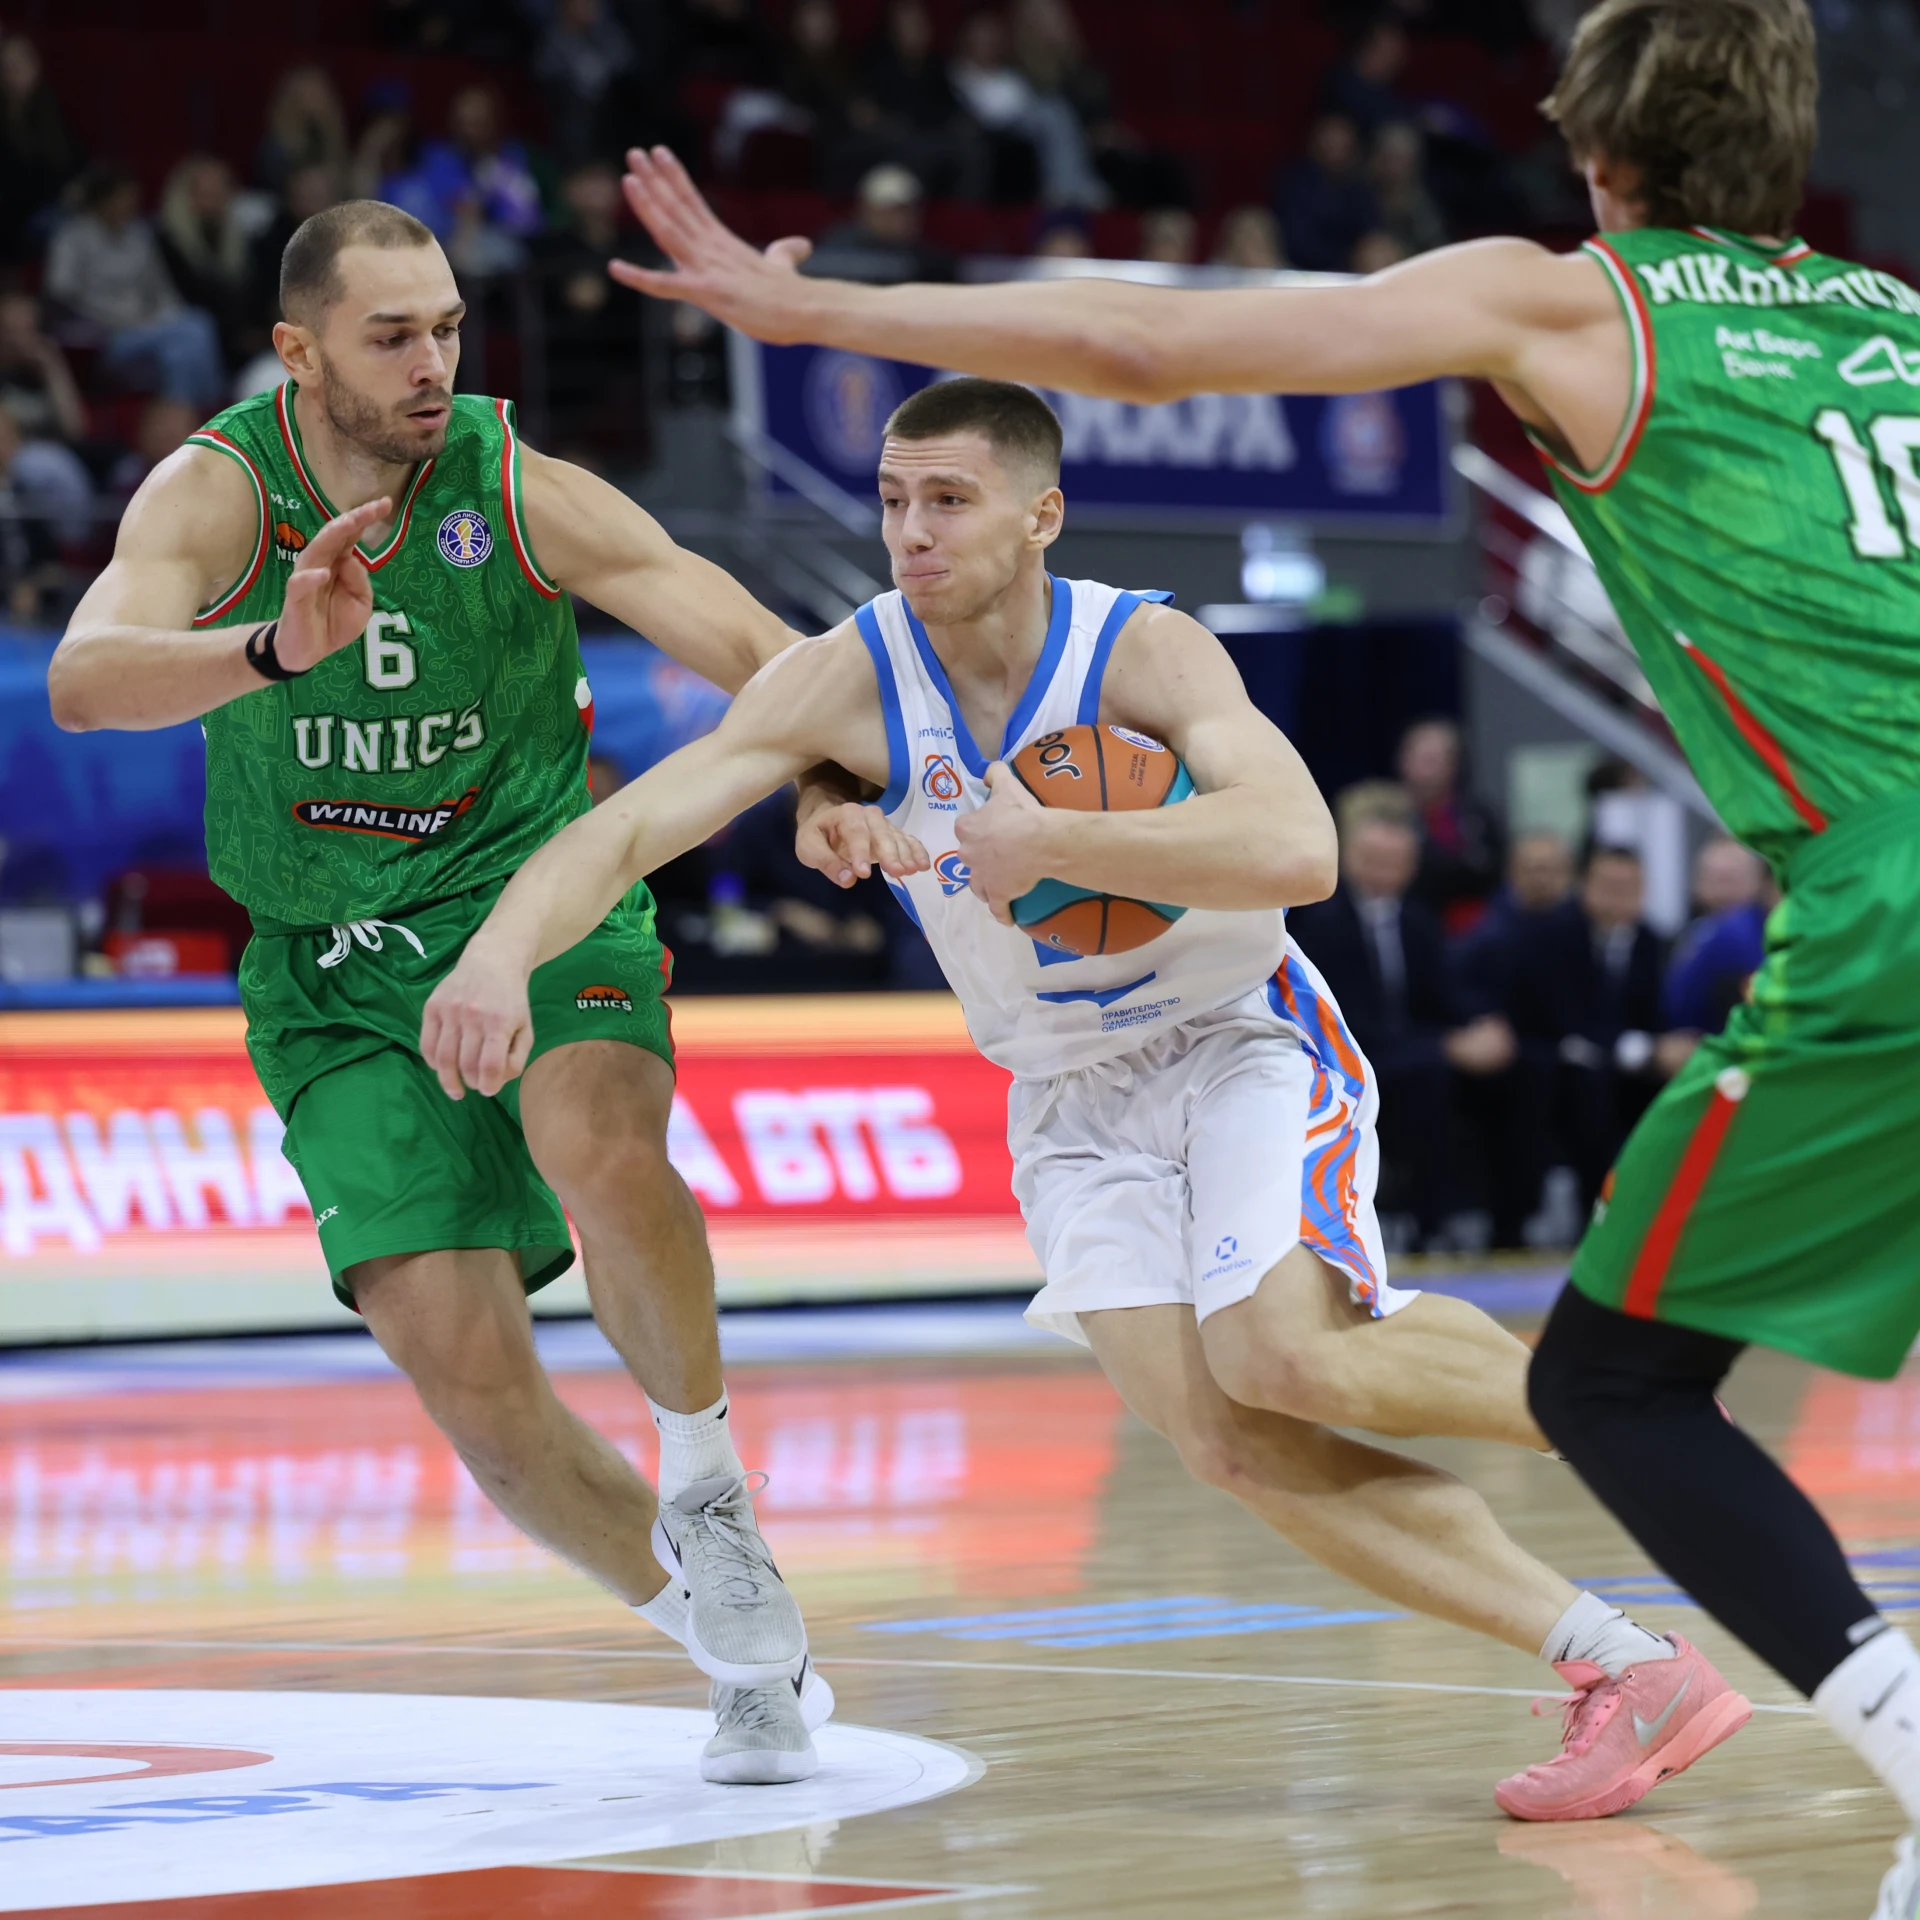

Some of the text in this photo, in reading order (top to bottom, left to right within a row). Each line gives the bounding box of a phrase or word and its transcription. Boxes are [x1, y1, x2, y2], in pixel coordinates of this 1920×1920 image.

[364, 609, 416, 690] 6
[292, 697, 485, 773] UNICS
[310, 804, 453, 834] WINLINE
[576, 999, 633, 1012] UNICS
[1101, 997, 1181, 1021] ПРАВИТЕЛЬСТВО
[730, 1083, 966, 1206] ВТБ
[0, 1782, 559, 1842] АРА
